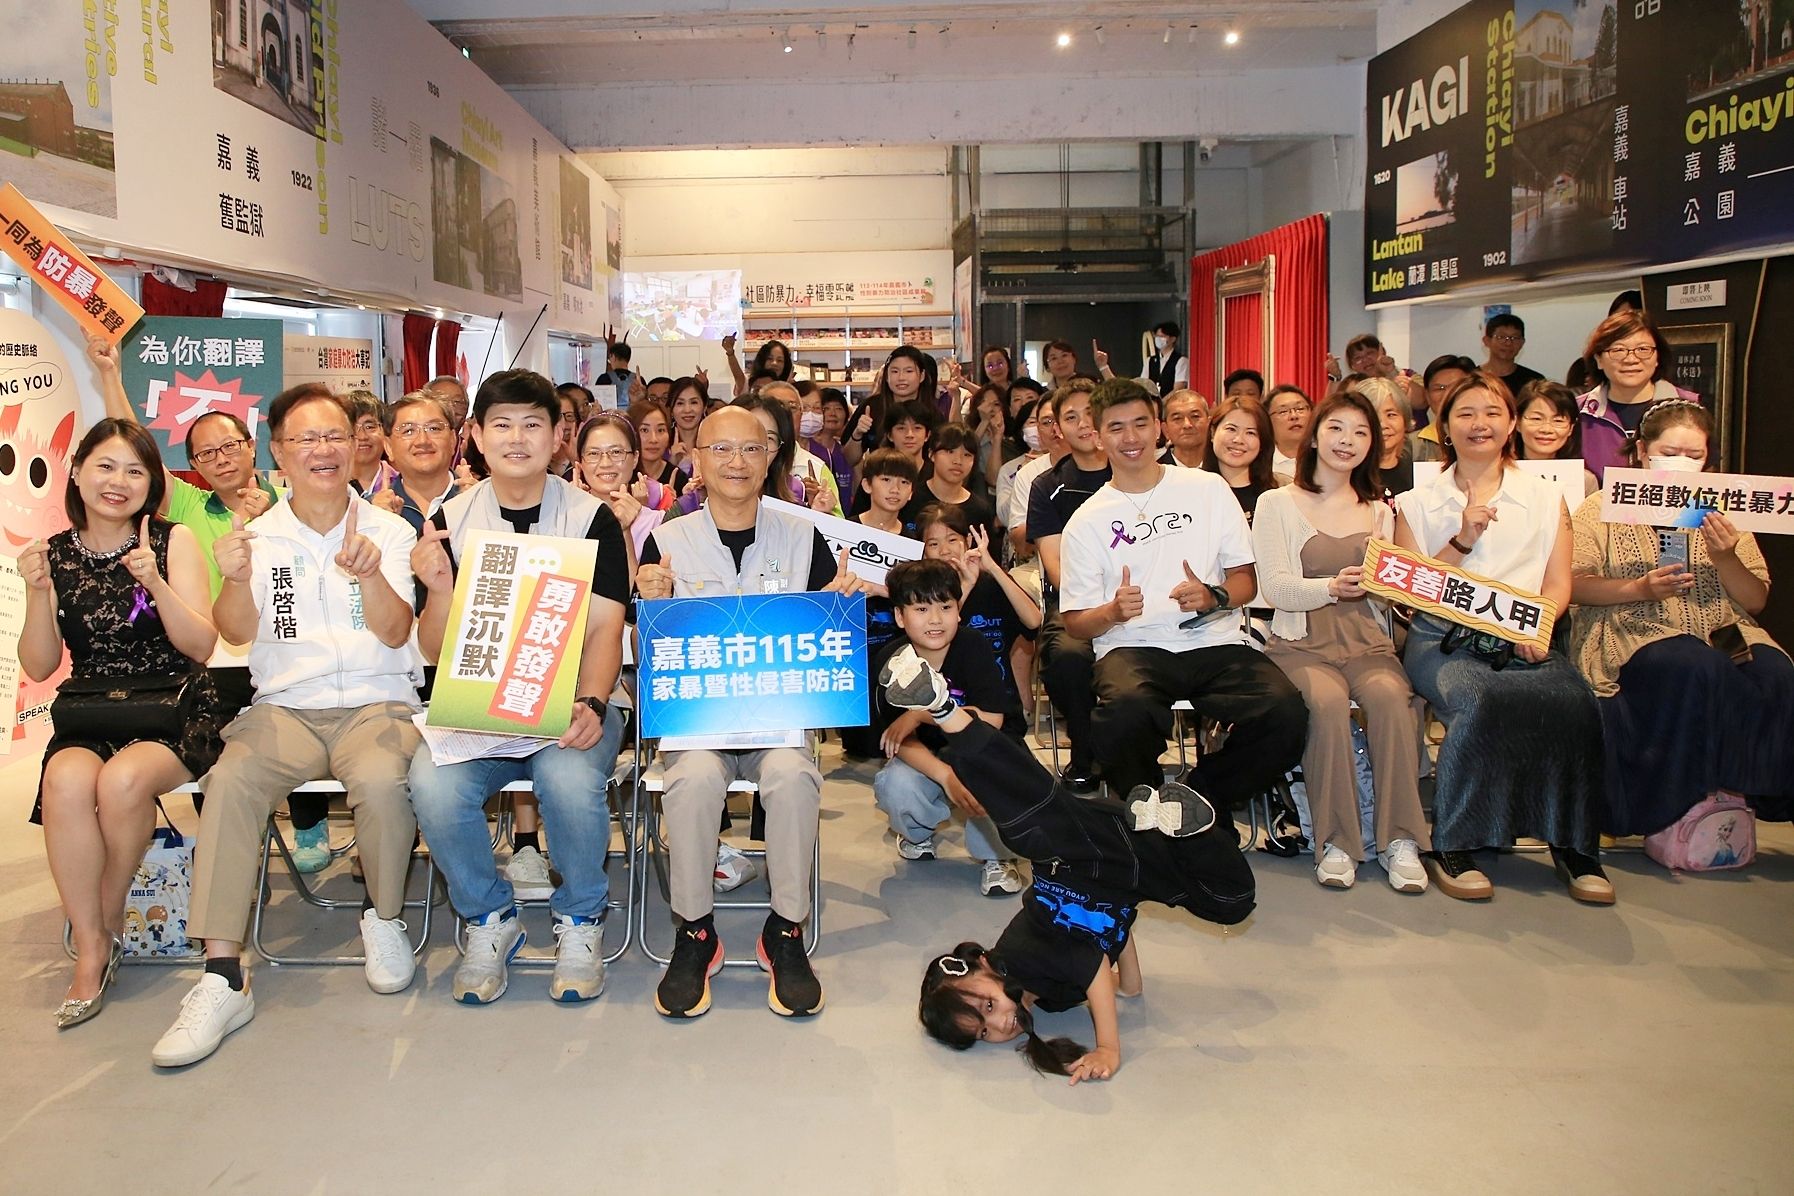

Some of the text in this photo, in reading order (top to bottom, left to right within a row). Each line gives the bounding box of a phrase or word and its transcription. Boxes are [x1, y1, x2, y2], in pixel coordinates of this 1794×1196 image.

[1500, 9, 1515, 147] Chiayi
[1382, 56, 1469, 147] KAGI
[1485, 17, 1499, 179] Station
[1685, 77, 1794, 144] Chiayi
[217, 133, 260, 182] 嘉義
[1684, 142, 1736, 182] 嘉義
[291, 170, 313, 191] 1922
[1374, 170, 1391, 185] 1620
[219, 192, 264, 238] 舊監獄
[1683, 190, 1735, 226] 公園
[1373, 232, 1423, 261] Lantan
[1483, 251, 1506, 267] 1902
[1372, 268, 1405, 292] Lake
[1430, 258, 1458, 283] 風景區
[138, 335, 265, 368] 為你翻譯
[23, 373, 53, 391] YOU
[458, 543, 519, 678] 翻譯沉默
[1378, 555, 1541, 632] 友善路人甲
[498, 578, 578, 718] 勇敢發聲
[651, 629, 853, 672] 嘉義市115年
[652, 667, 855, 701] 家暴暨性侵害防治
[18, 703, 50, 722] SPEAK
[131, 889, 145, 897] ANNA
[1051, 886, 1065, 894] ARE
